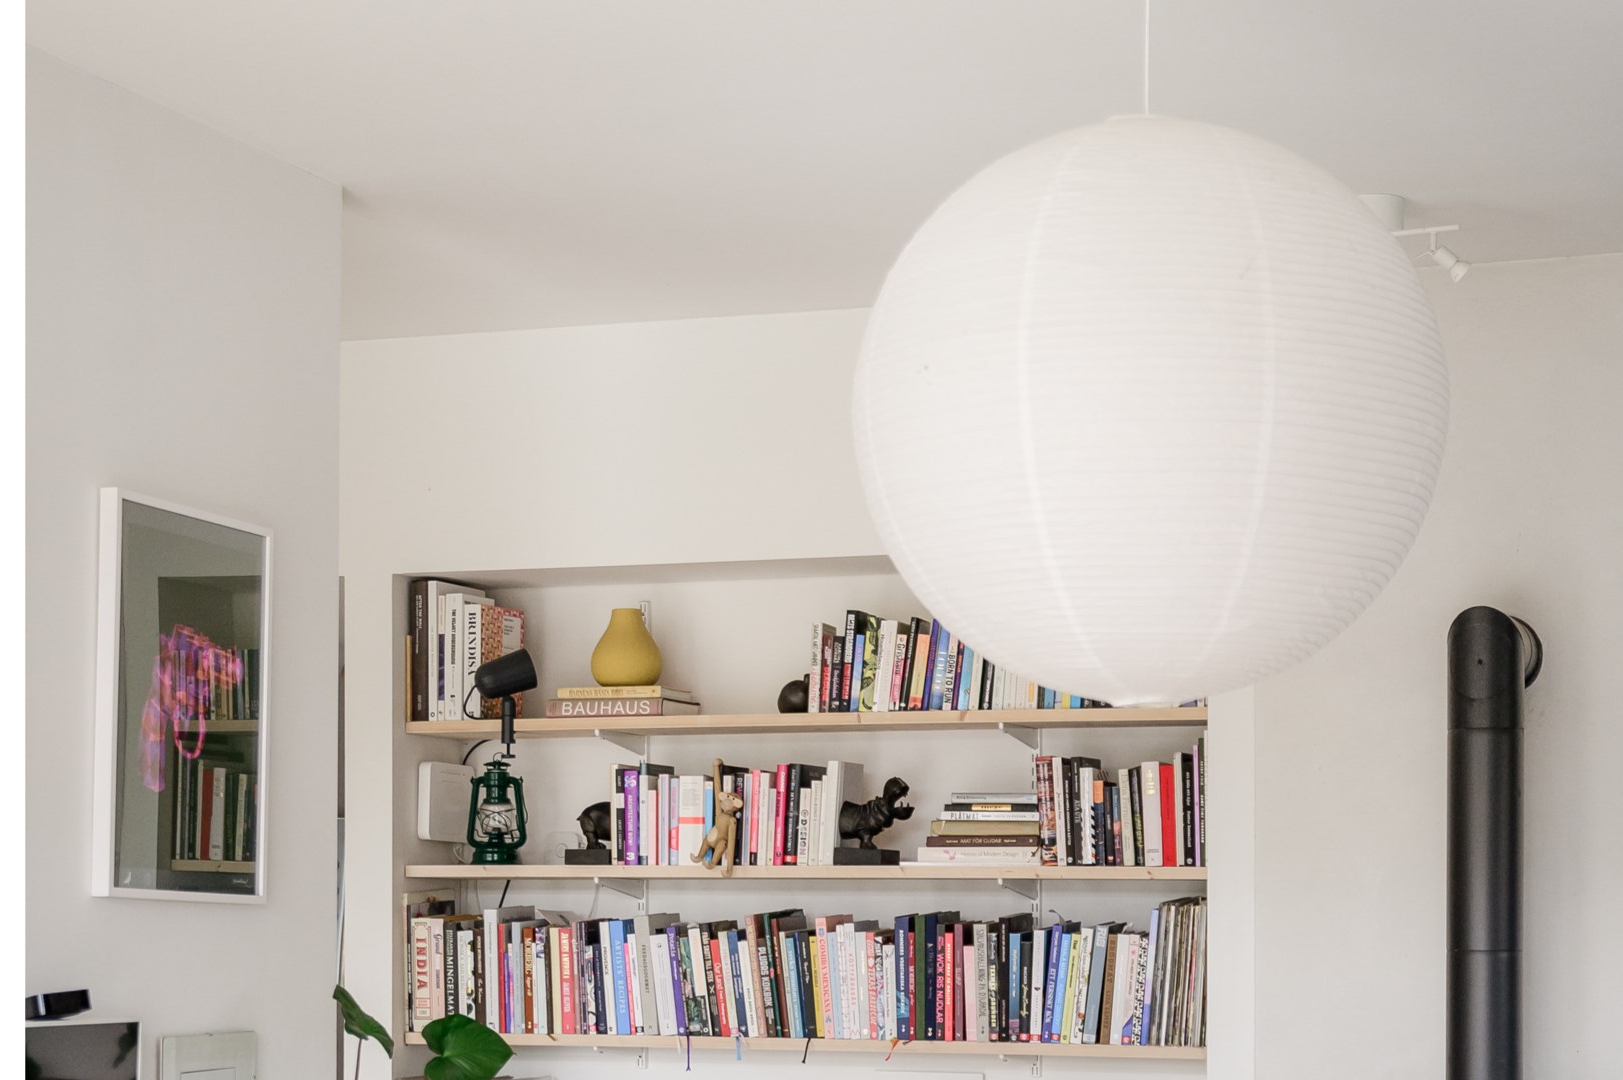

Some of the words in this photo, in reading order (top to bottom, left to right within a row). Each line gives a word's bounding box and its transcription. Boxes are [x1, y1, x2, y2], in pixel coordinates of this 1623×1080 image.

[468, 612, 477, 676] BRINDISA
[946, 654, 955, 674] BORN
[945, 675, 953, 686] TO
[944, 687, 953, 704] RUN
[561, 700, 651, 716] BAUHAUS
[434, 934, 443, 955] Grand
[416, 937, 428, 990] INDIA
[714, 962, 722, 975] Our
[936, 953, 944, 974] WOK
[761, 977, 773, 1008] KOKBOK
[936, 975, 944, 989] RIS
[618, 979, 626, 1014] RECIPES
[823, 973, 831, 1013] MEXICANA
[936, 990, 944, 1024] NUDLAR
